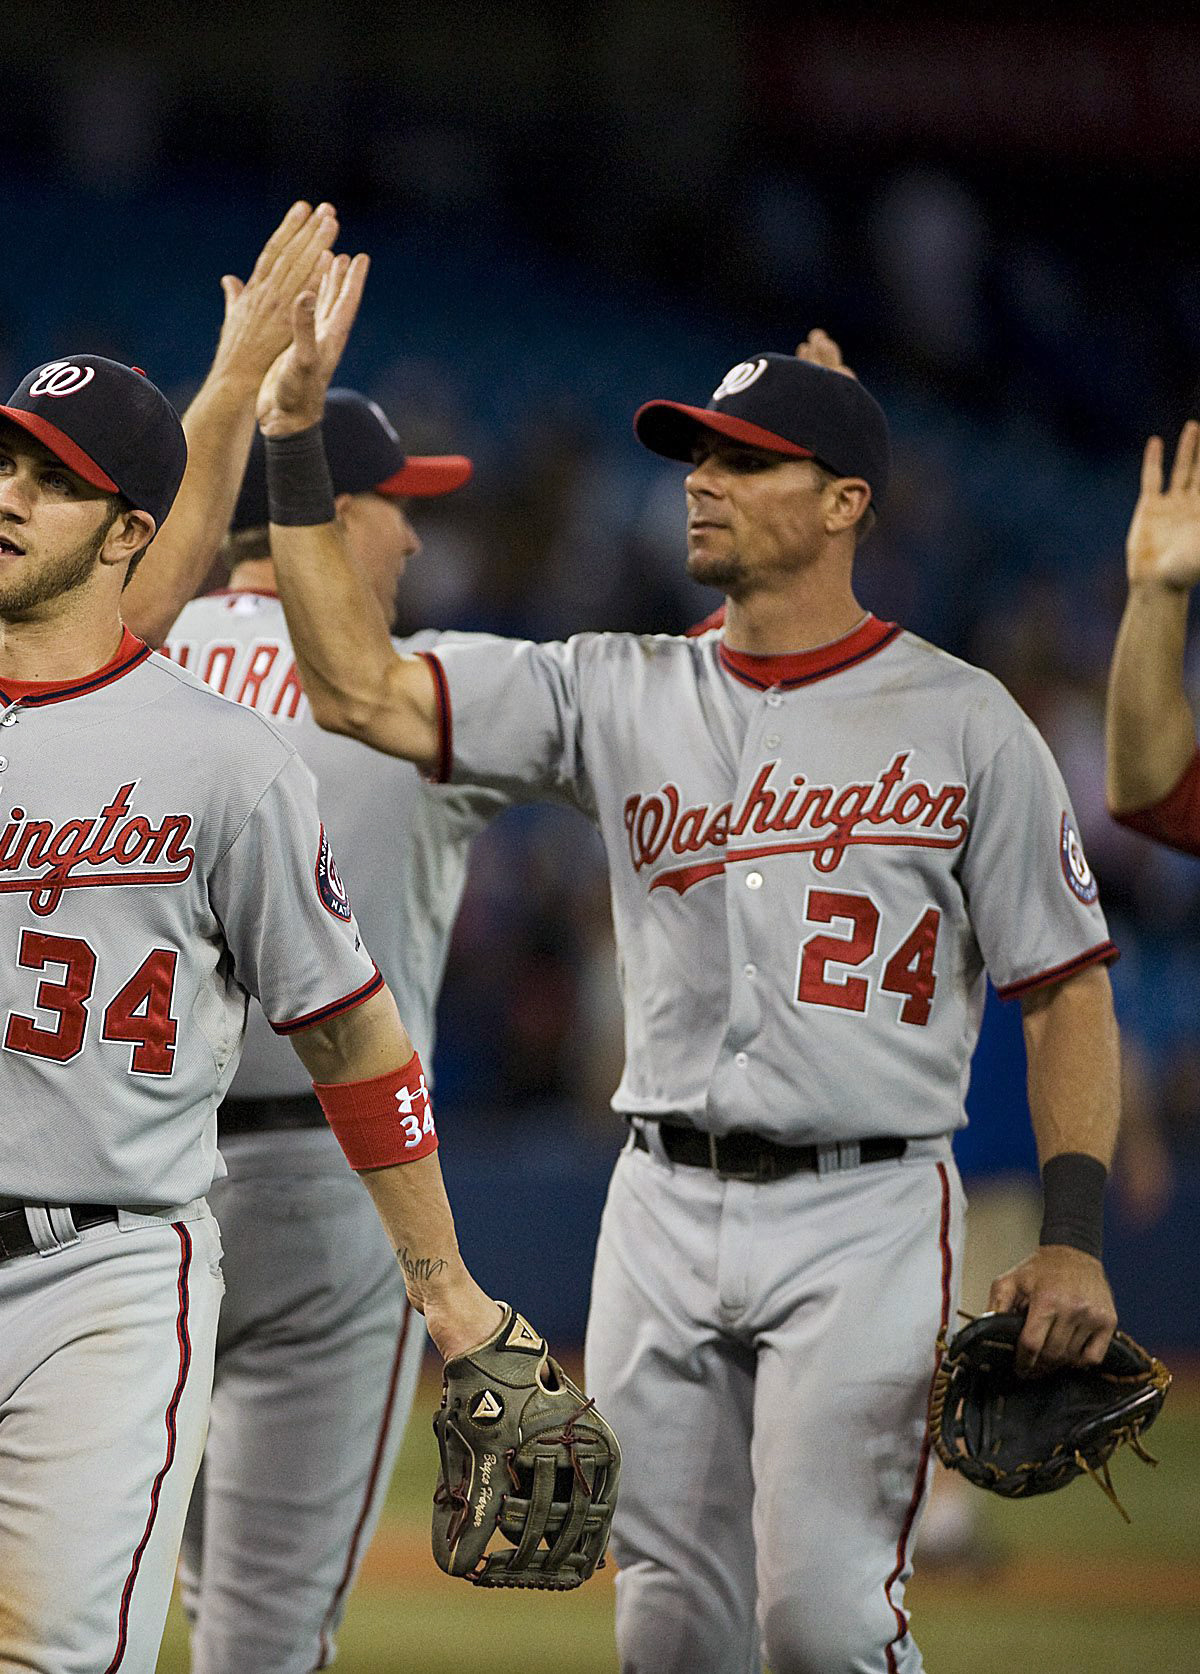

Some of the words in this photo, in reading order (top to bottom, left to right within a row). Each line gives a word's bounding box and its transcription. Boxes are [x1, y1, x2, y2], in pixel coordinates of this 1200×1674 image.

[30, 361, 95, 398] W
[624, 750, 969, 878] Washington
[794, 885, 942, 1027] 24
[2, 926, 181, 1078] 34
[400, 1102, 435, 1148] 34
[479, 1453, 497, 1485] Bryce
